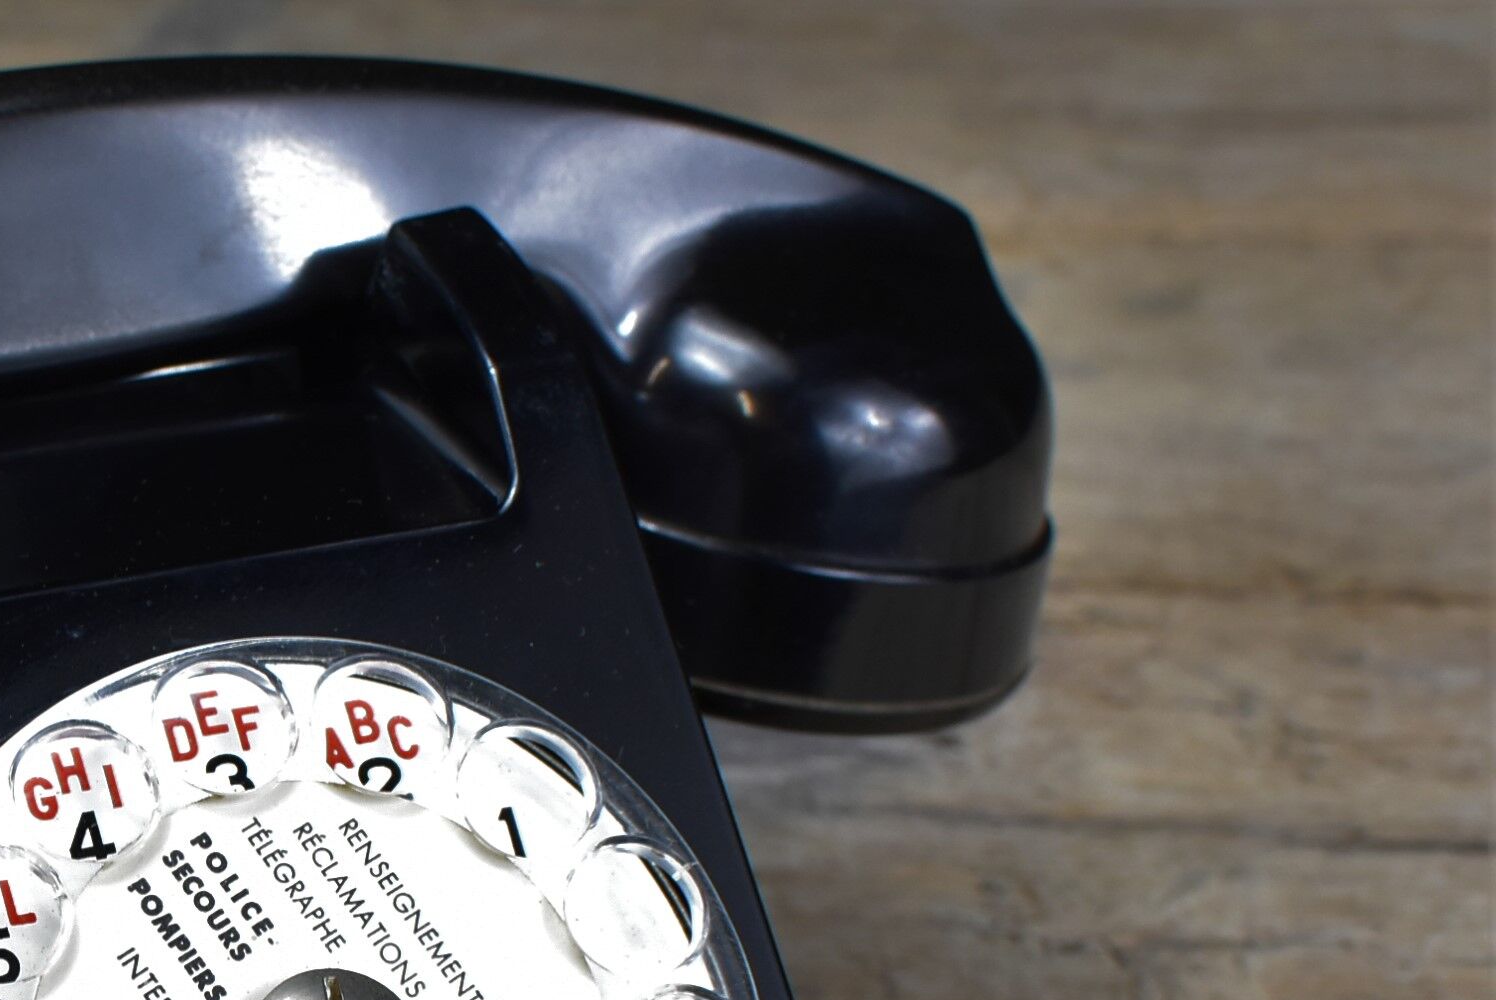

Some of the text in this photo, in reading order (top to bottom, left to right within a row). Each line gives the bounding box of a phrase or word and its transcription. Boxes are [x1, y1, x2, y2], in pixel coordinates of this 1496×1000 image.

[161, 690, 259, 762] DEF
[325, 699, 419, 769] ABC
[23, 747, 124, 821] GHI
[69, 810, 116, 861] 4
[497, 806, 527, 858] 1
[162, 849, 252, 962] SECOURS
[241, 817, 346, 953] TÉLÉGRAPHE
[293, 822, 426, 998] RÉCLAMATIONS
